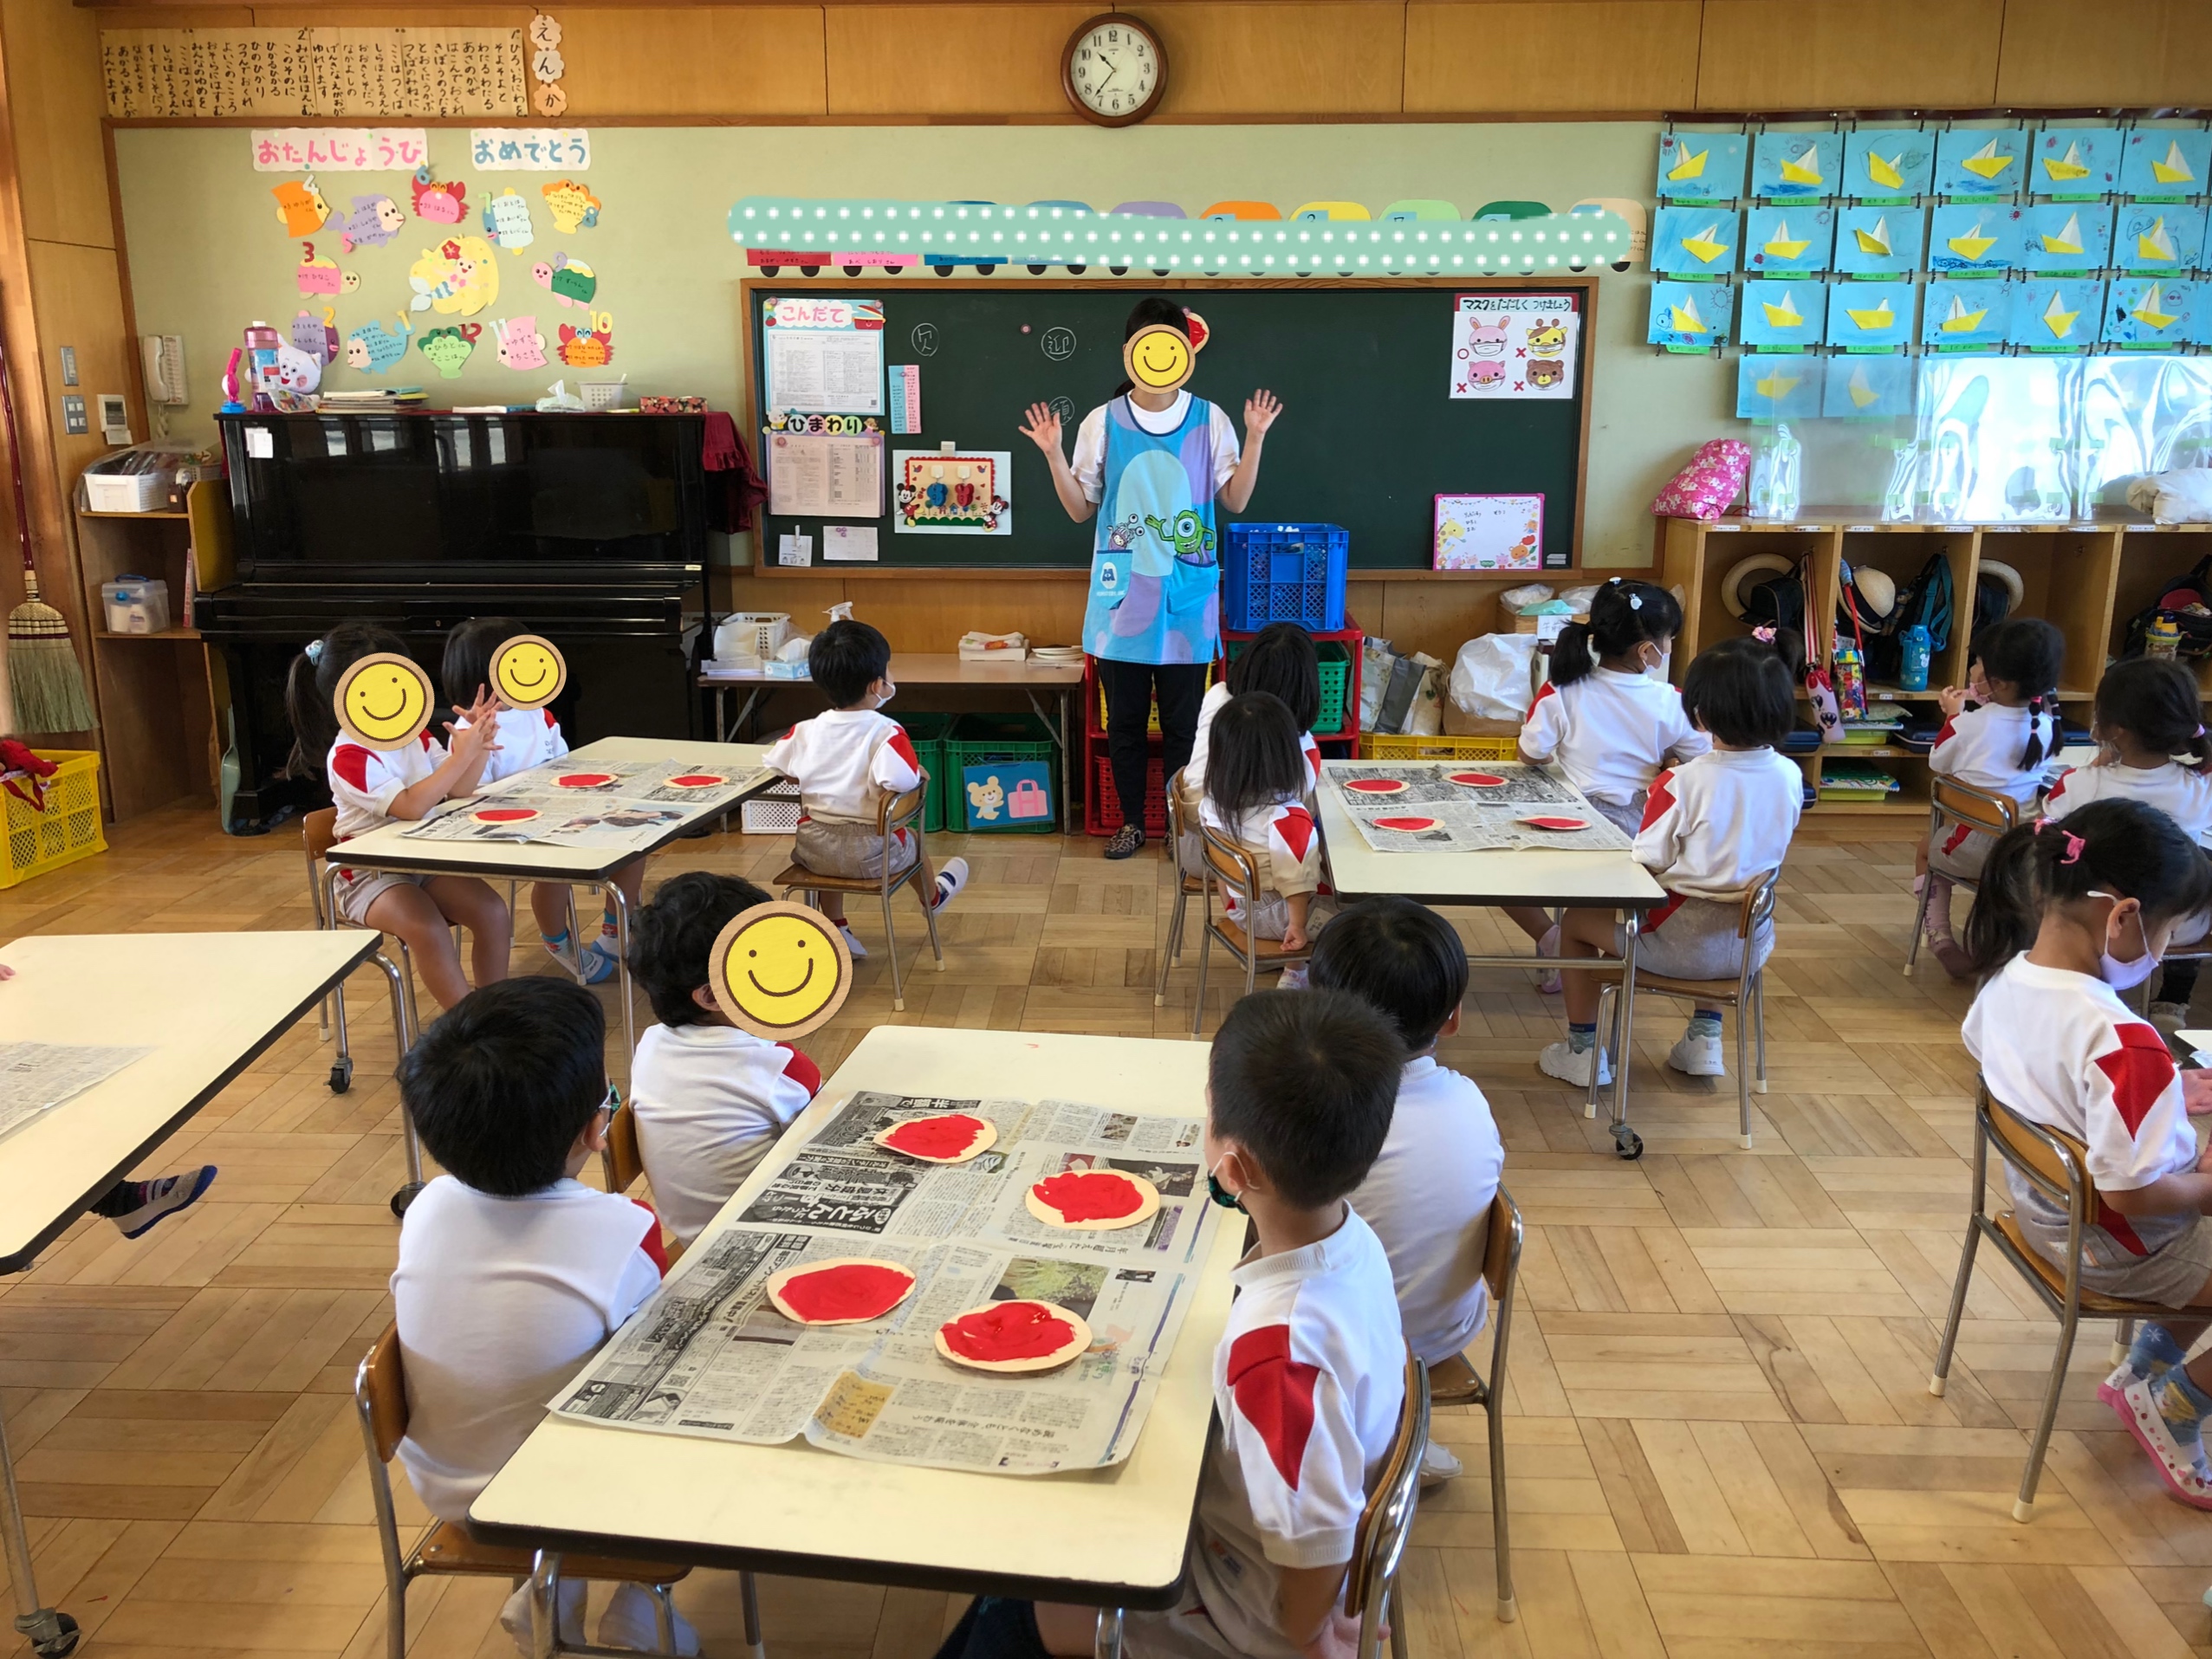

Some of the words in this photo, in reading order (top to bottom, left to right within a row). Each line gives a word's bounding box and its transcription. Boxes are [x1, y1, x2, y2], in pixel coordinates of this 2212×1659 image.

[1093, 36, 1102, 47] 11
[1108, 29, 1118, 42] 12
[1126, 33, 1132, 45] 1
[1081, 49, 1091, 61] 10
[1137, 45, 1145, 57] 2
[104, 46, 117, 105] よんでます
[147, 44, 163, 114] すくすくそだつ
[191, 42, 207, 108] みんなのゆめを
[223, 42, 237, 113] よいこのこころ
[238, 43, 253, 107] つつんでおくれ
[251, 42, 266, 98] ひのひかり
[267, 42, 282, 96] ひかるひかる
[283, 43, 295, 97] このそのに
[313, 44, 328, 99] ゆれてます
[327, 42, 346, 117] げんきなえがおが
[343, 44, 357, 96] なかよしの
[359, 44, 374, 108] おおきくそだつ
[404, 44, 419, 108] つくばのみねに
[418, 42, 435, 112] とおくにうかぶ
[446, 42, 465, 115] はこんでおくれ
[463, 42, 481, 96] あさのかぜ
[495, 42, 507, 103] そよそよと
[1078, 67, 1086, 78] 9
[1144, 62, 1151, 75] 3
[434, 43, 447, 119] きぼうのうたを
[1084, 83, 1093, 95] 8
[1138, 80, 1145, 92] 4
[1097, 95, 1104, 107] 7
[1112, 99, 1119, 110] 6
[1128, 94, 1135, 105] 5
[258, 137, 423, 166] おたんじょうび
[474, 138, 587, 165] おめでとう
[302, 174, 320, 196] 4
[416, 165, 431, 185] 6
[478, 191, 492, 214] 7
[582, 205, 599, 229] 8
[302, 242, 315, 262] 3
[341, 232, 354, 255] 5
[553, 249, 568, 272] 9
[322, 307, 335, 328] 2
[397, 309, 412, 331] 1
[589, 310, 613, 334] 10
[782, 306, 846, 323] こんだて
[458, 322, 483, 345] 12
[489, 318, 510, 341] 11
[1048, 334, 1071, 355] 迎
[790, 417, 860, 434] ひまわり
[808, 1202, 877, 1223] ふとん
